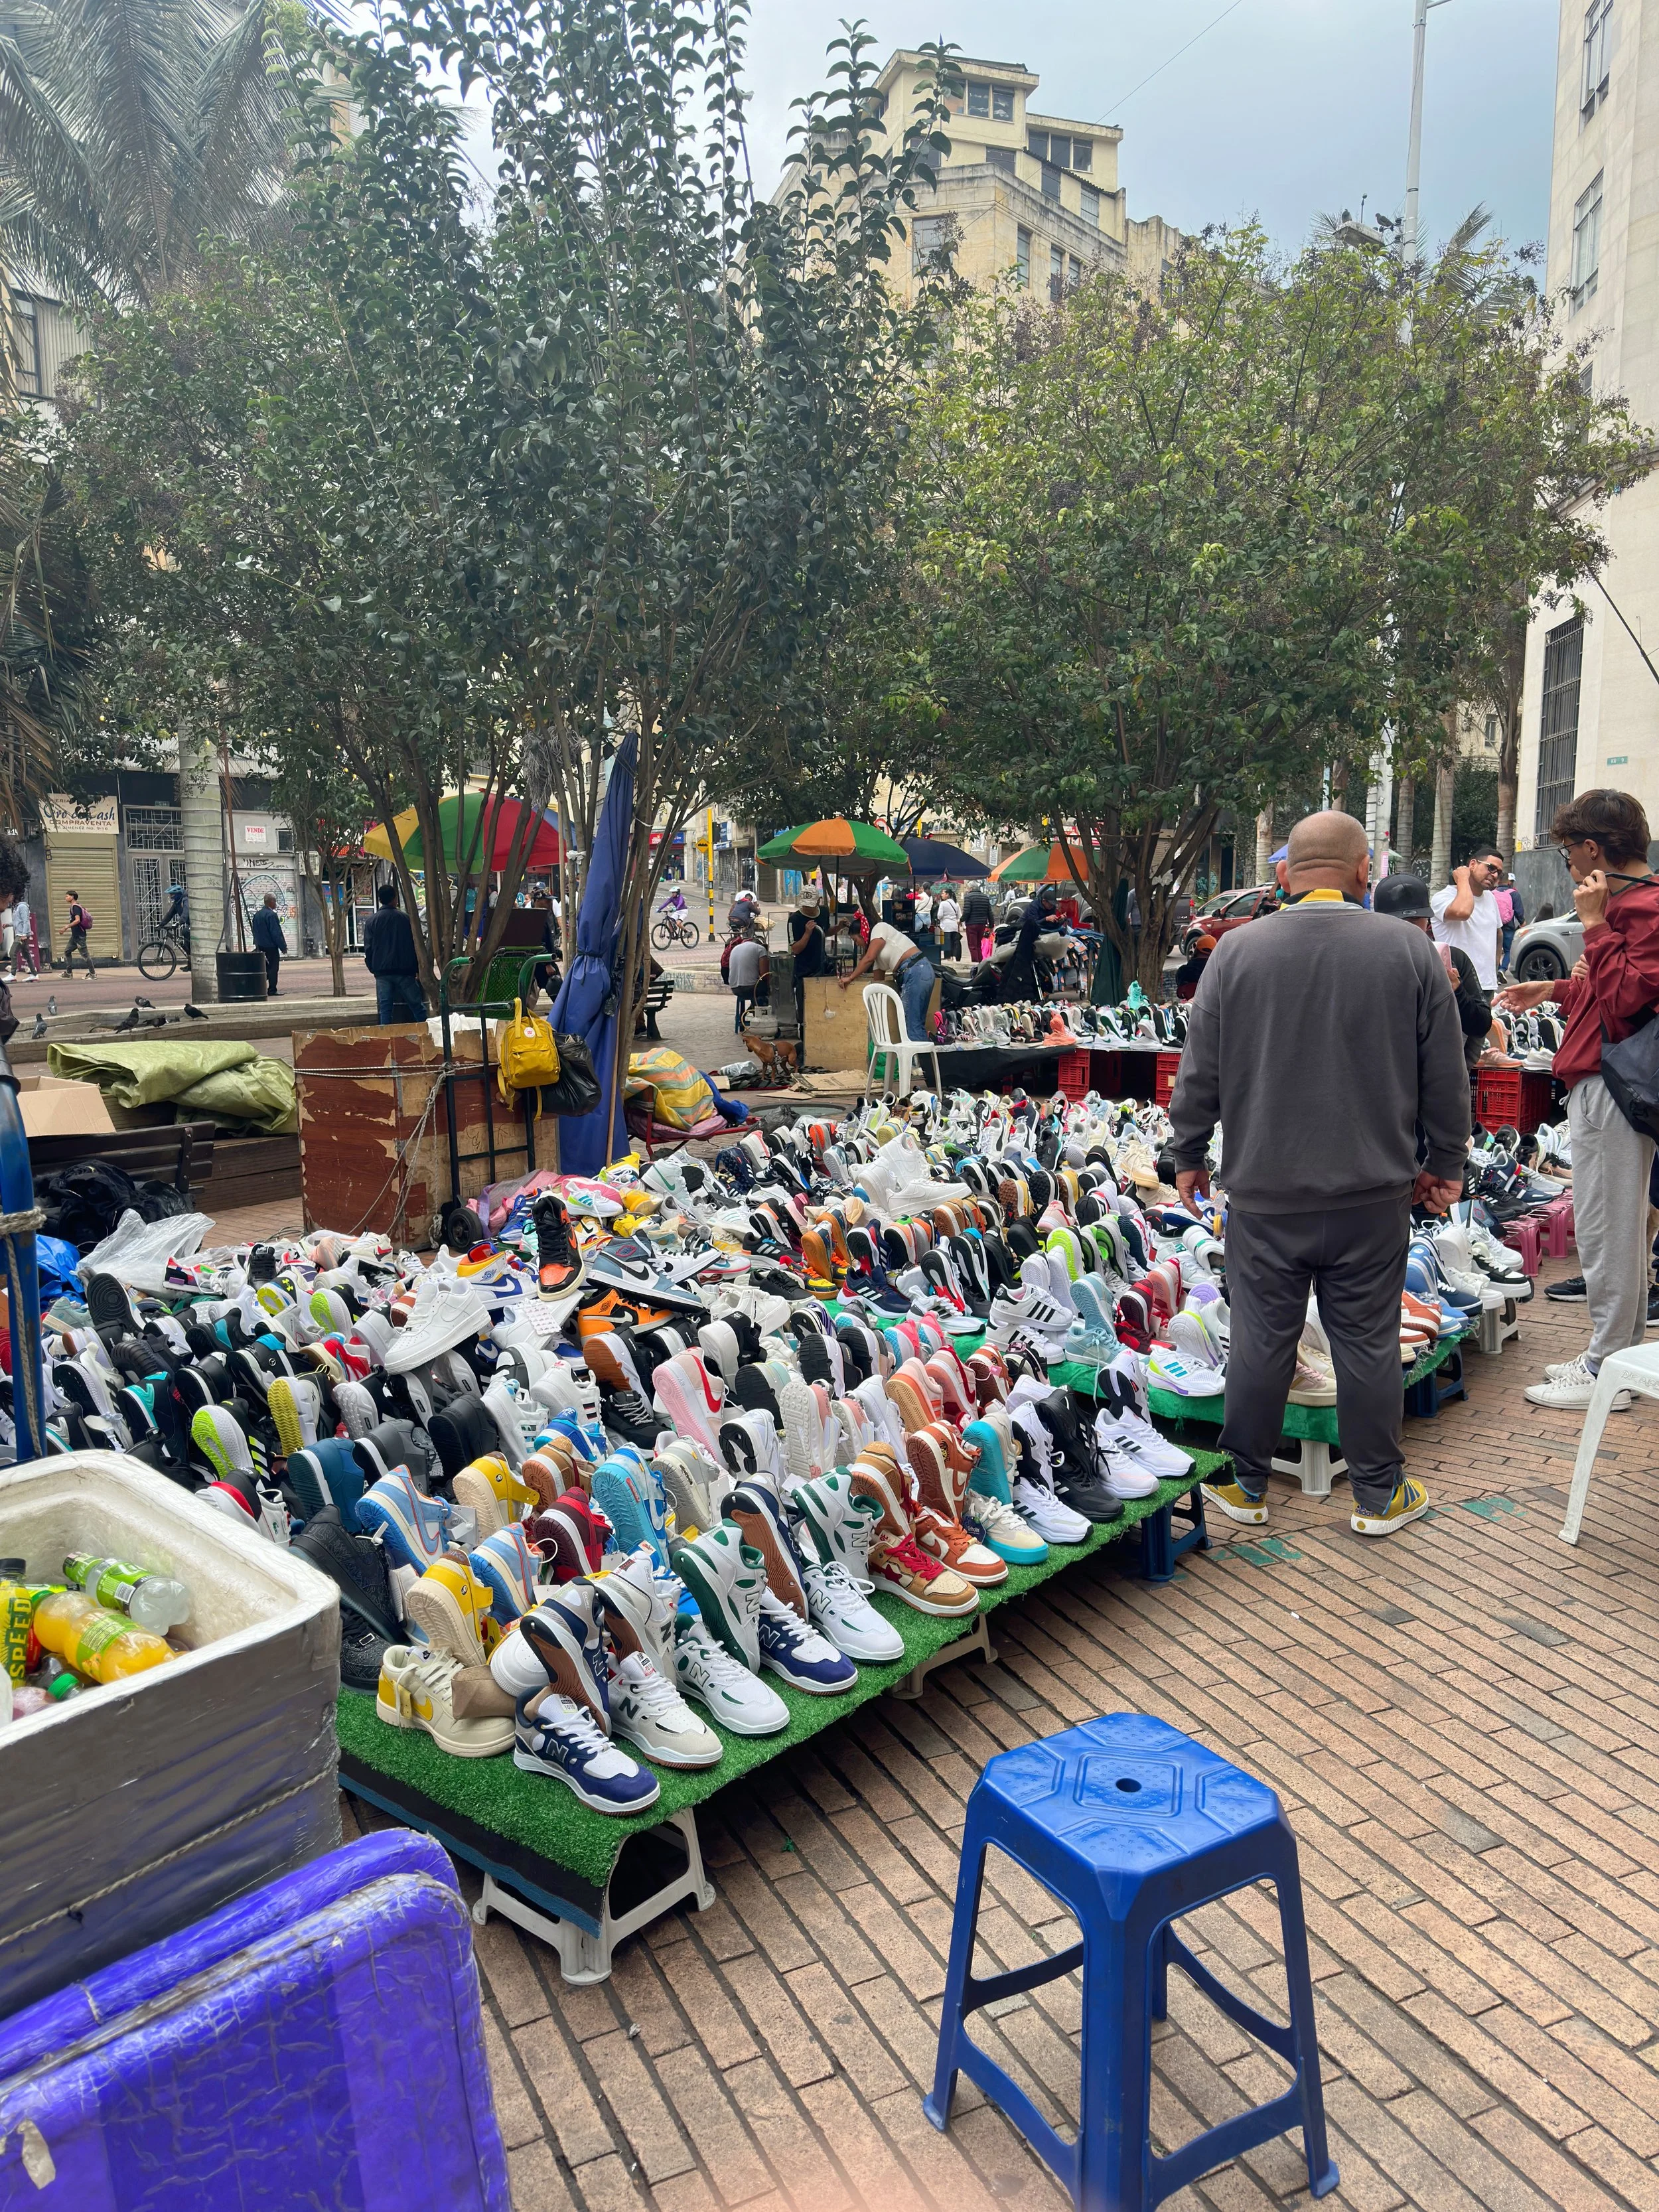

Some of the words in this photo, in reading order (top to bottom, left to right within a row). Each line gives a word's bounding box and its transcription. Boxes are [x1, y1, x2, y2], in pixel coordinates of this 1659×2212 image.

[1354, 1508, 1375, 1517] adidas
[852, 1532, 868, 1548] N
[745, 1592, 760, 1614] N
[808, 1589, 831, 1613] N
[9, 1597, 32, 1678] SPEED
[689, 1662, 710, 1687] N
[618, 1696, 640, 1720] N
[545, 1738, 569, 1763] N
